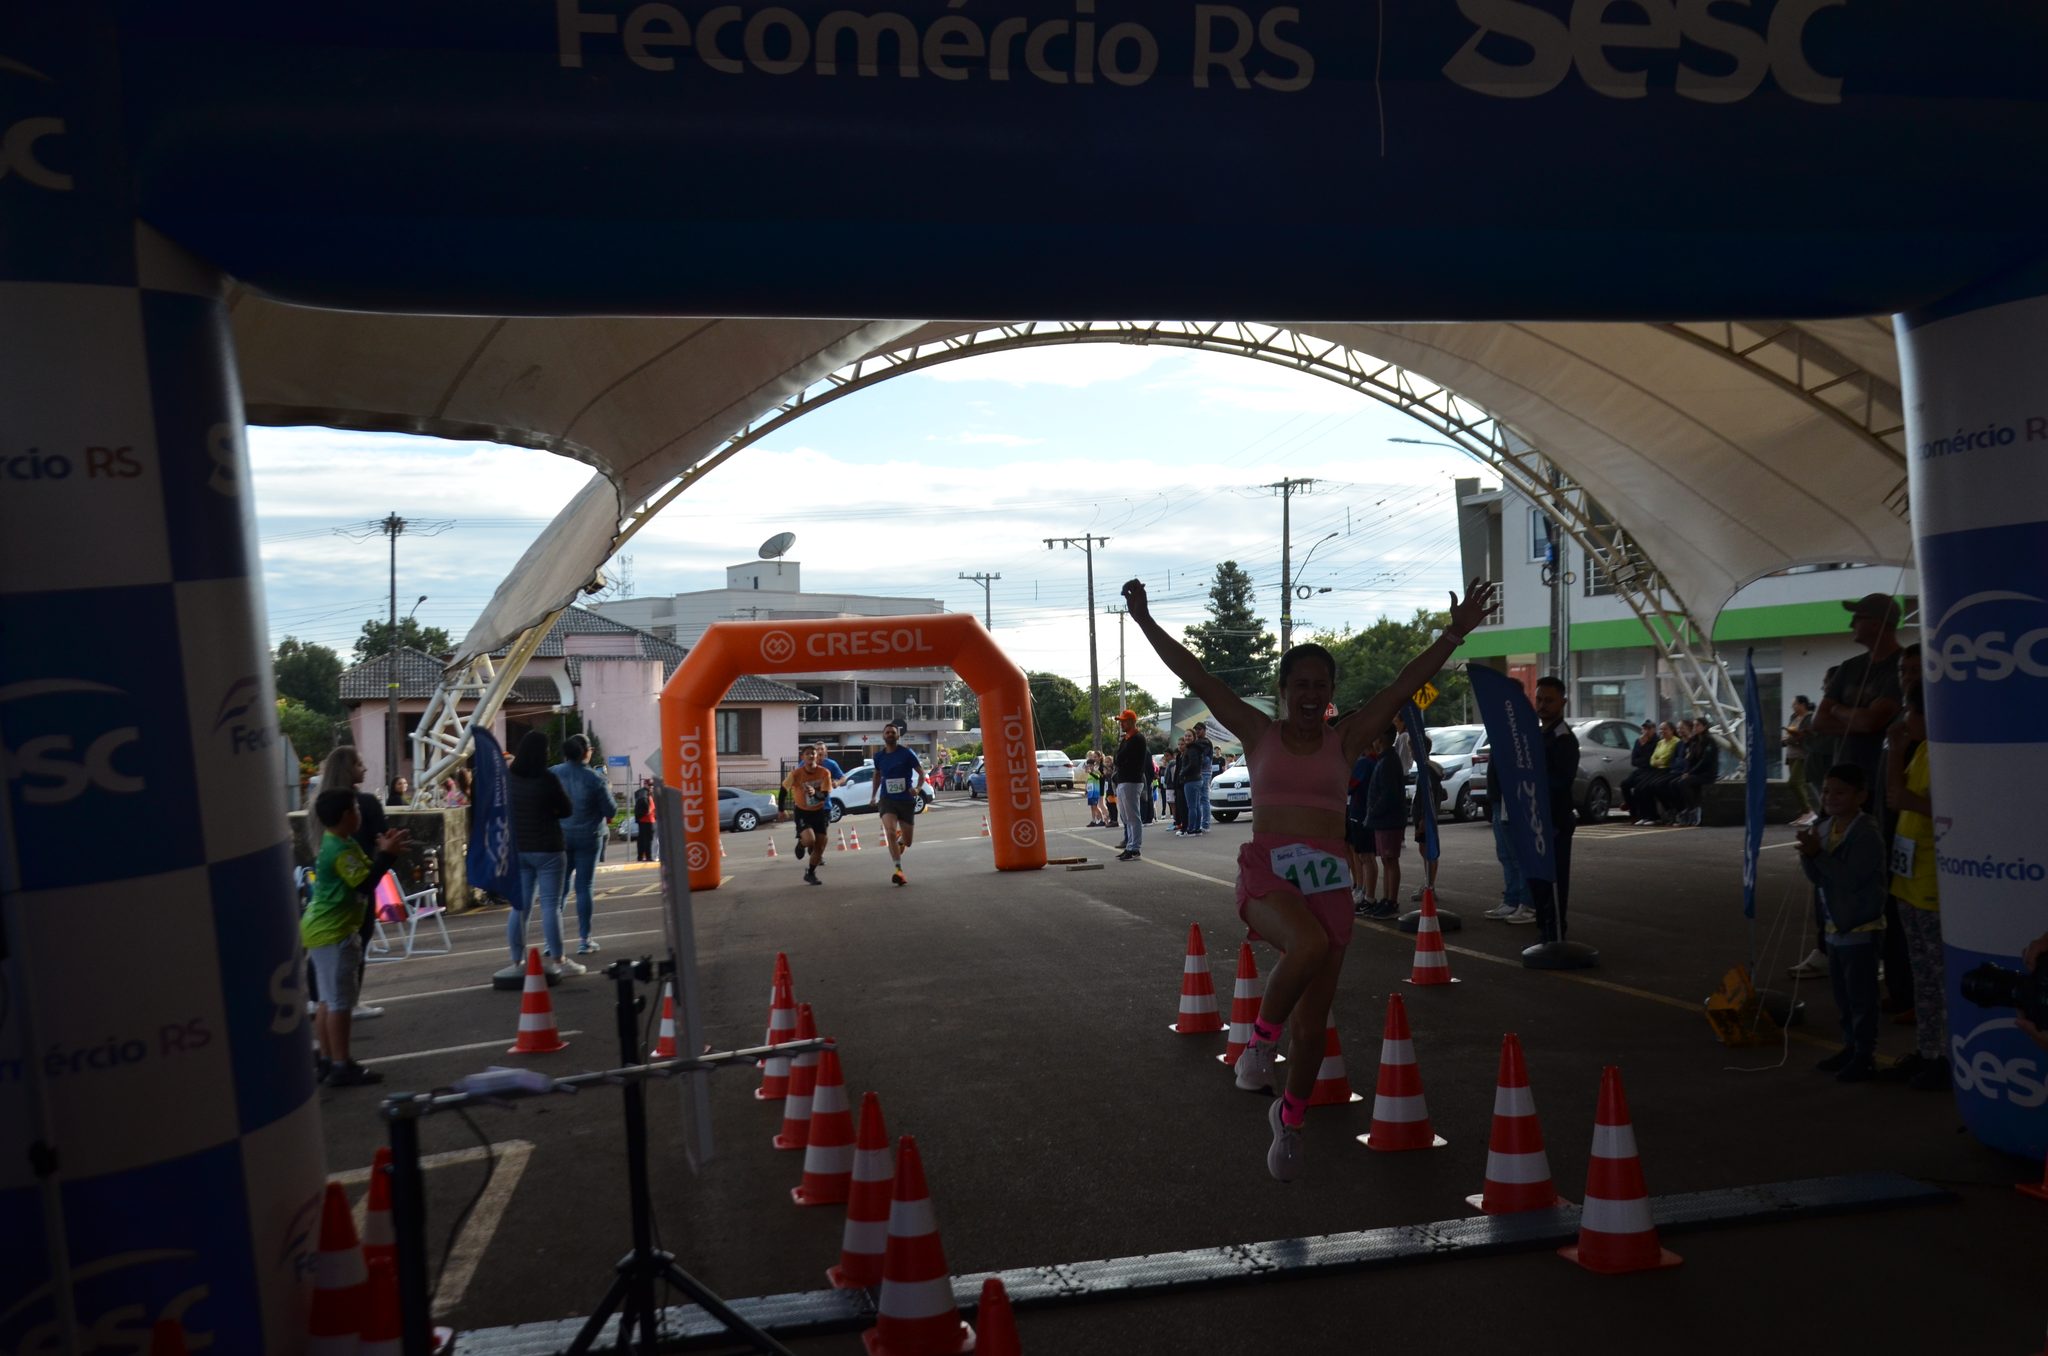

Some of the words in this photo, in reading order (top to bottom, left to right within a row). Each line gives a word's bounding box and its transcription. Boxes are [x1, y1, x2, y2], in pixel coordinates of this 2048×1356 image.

[558, 0, 1160, 87] Fecomércio
[1193, 4, 1316, 92] RS
[1442, 0, 1847, 105] Sesc
[85, 446, 143, 479] RS
[806, 628, 933, 657] CRESOL
[1002, 705, 1032, 811] CRESOL
[679, 725, 705, 834] CRESOL
[888, 783, 904, 793] 294
[1284, 857, 1342, 889] 112
[158, 1017, 212, 1056] RS
[1951, 1033, 2048, 1108] Ses
